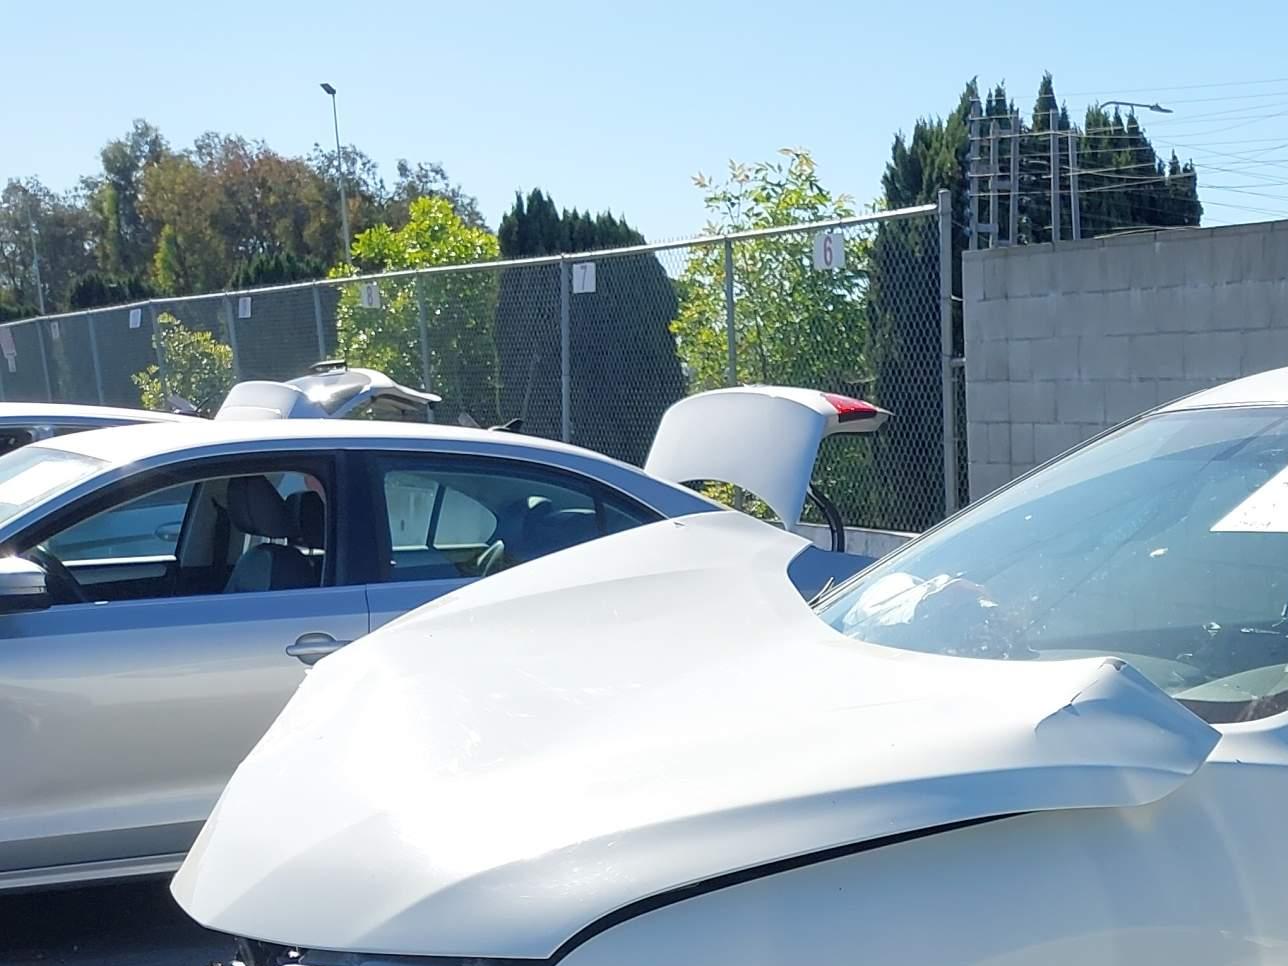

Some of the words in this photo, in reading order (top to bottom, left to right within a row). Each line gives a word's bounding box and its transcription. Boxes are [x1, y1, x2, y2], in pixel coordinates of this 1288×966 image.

[822, 235, 833, 267] 6
[579, 264, 588, 291] 7
[366, 285, 374, 306] 8
